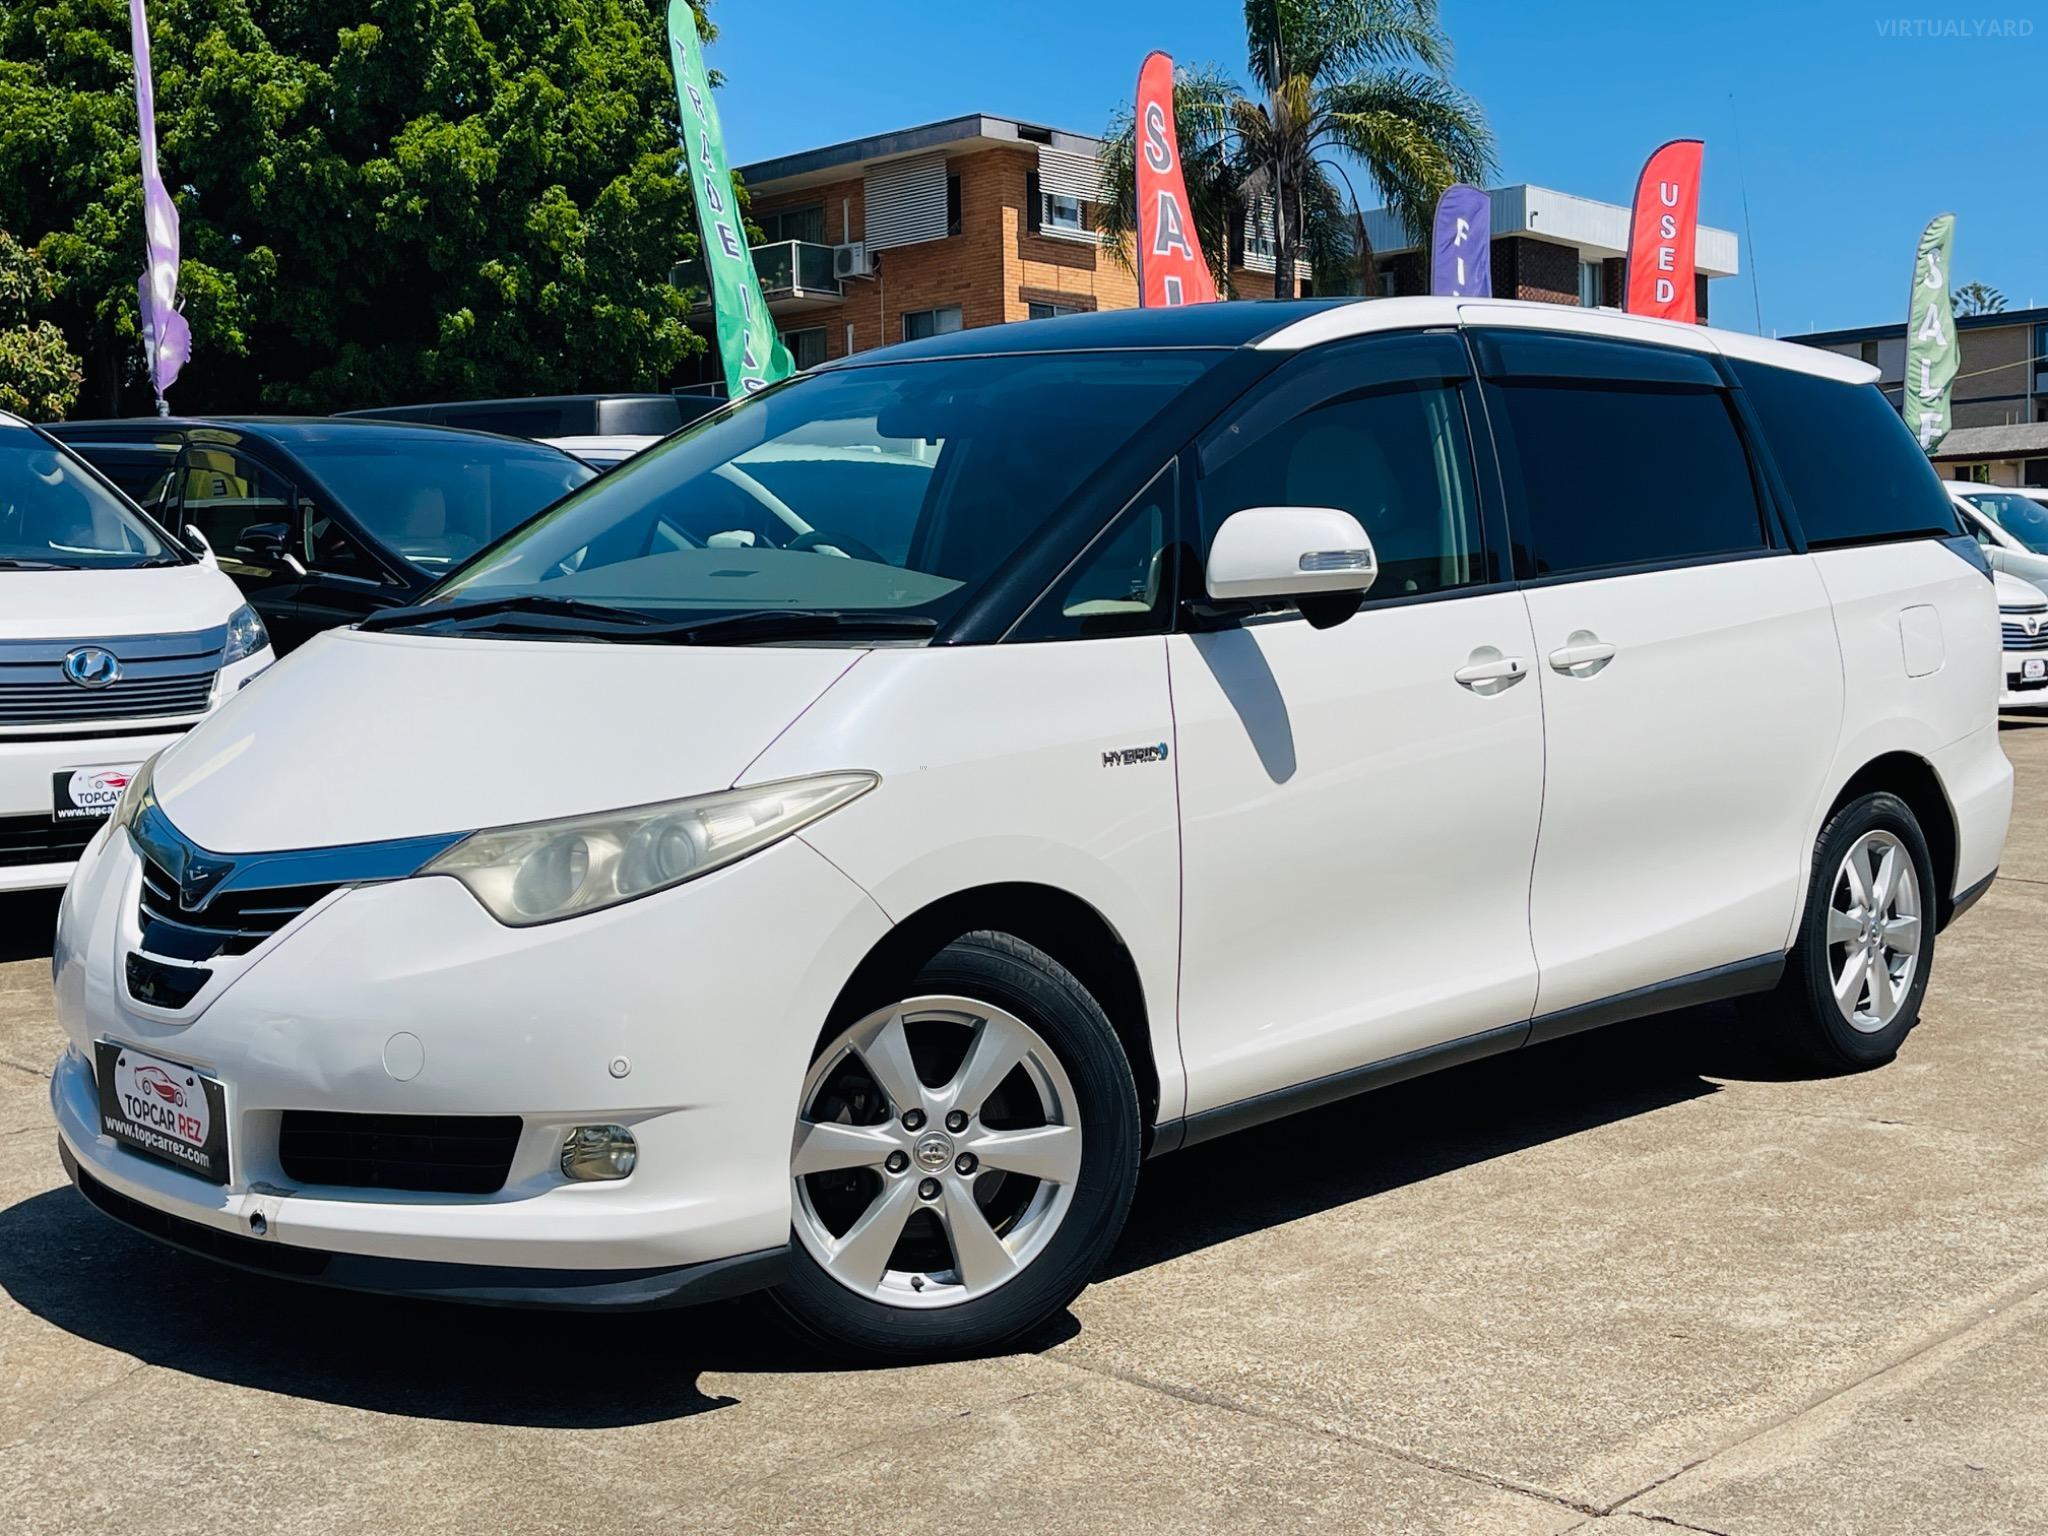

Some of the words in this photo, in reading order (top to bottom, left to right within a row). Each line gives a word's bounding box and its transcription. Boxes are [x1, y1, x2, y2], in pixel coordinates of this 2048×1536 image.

[1452, 217, 1470, 296] FI
[1656, 181, 1679, 303] USED
[1102, 742, 1168, 767] HYBRID
[105, 1115, 210, 1168] www.topcarrez.com
[124, 1093, 176, 1133] TOPCAR
[178, 1113, 203, 1143] REZ
